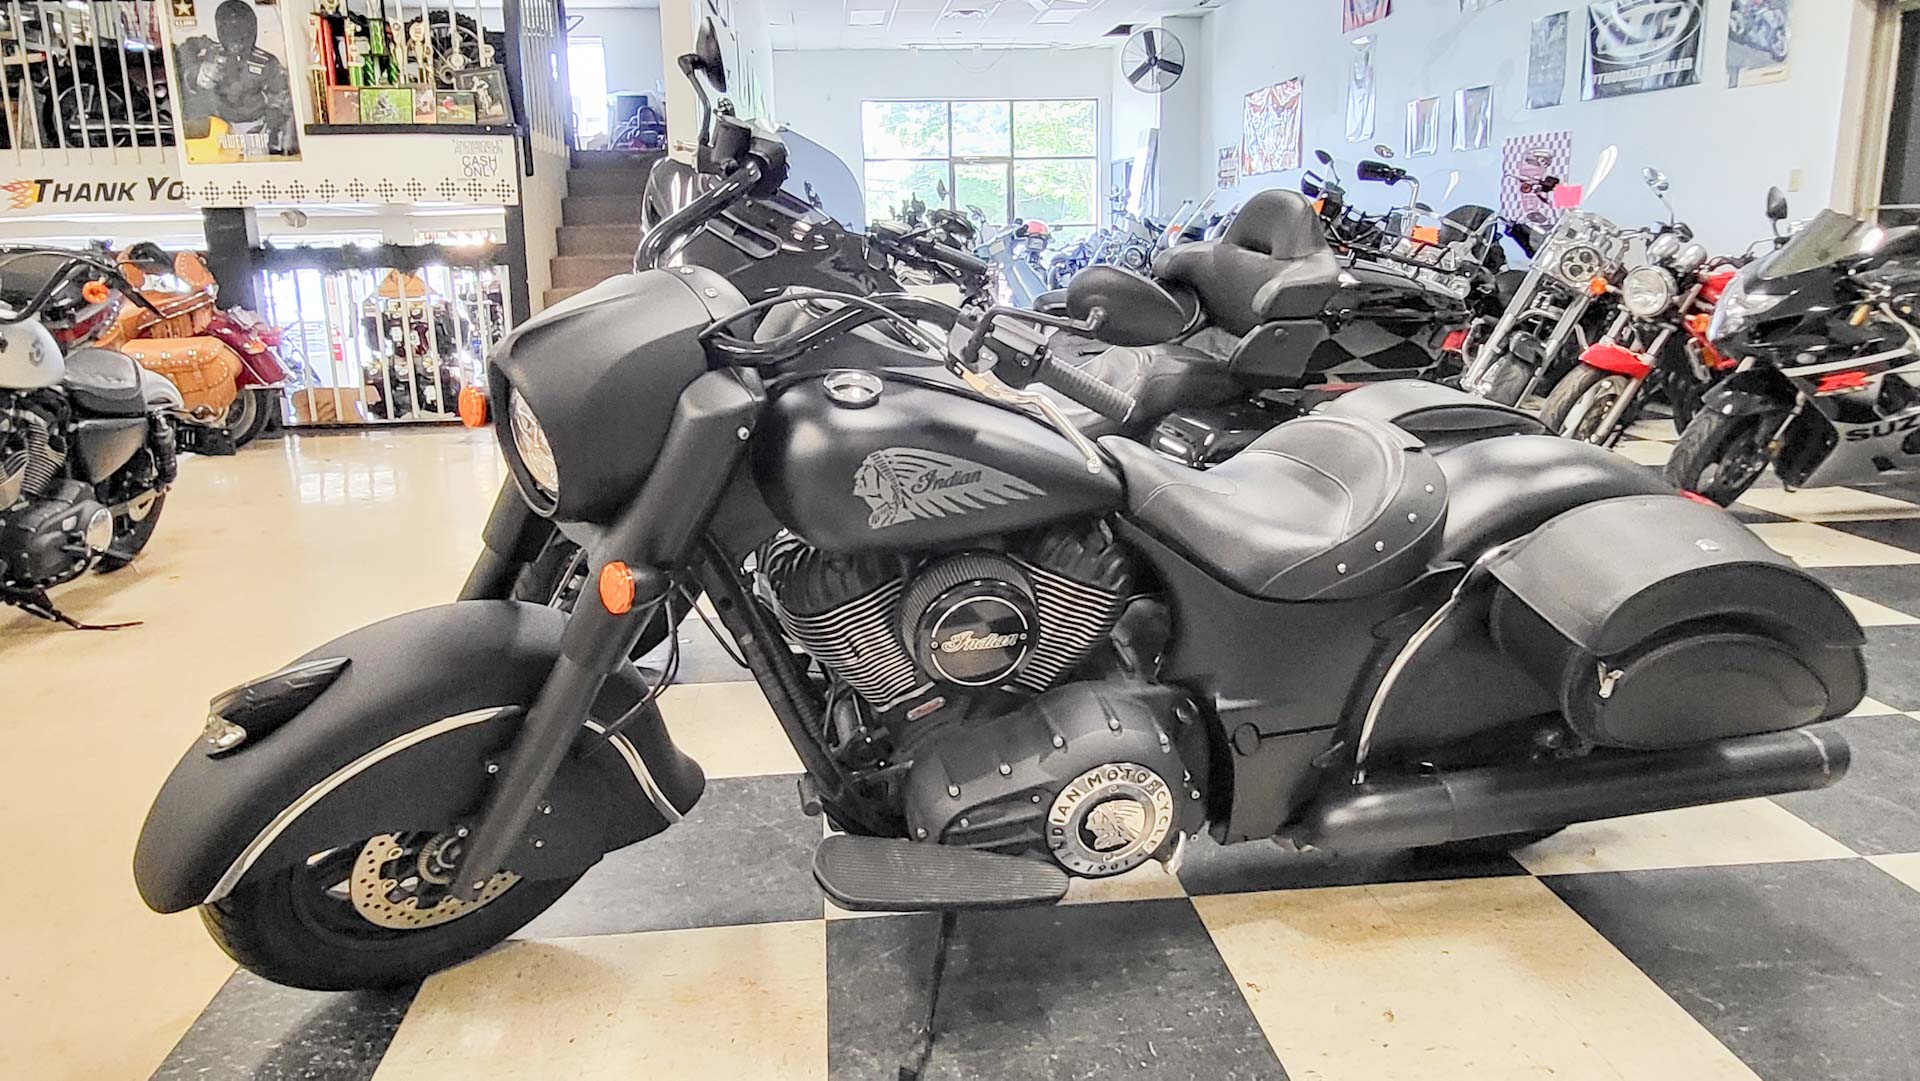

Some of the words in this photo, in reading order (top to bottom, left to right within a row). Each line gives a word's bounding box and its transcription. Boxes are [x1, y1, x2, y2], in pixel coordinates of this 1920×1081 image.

[462, 155, 498, 167] CASH
[464, 166, 497, 177] ONLY
[34, 179, 138, 203] THANK
[911, 469, 982, 494] Indian
[941, 630, 1019, 653] Indian
